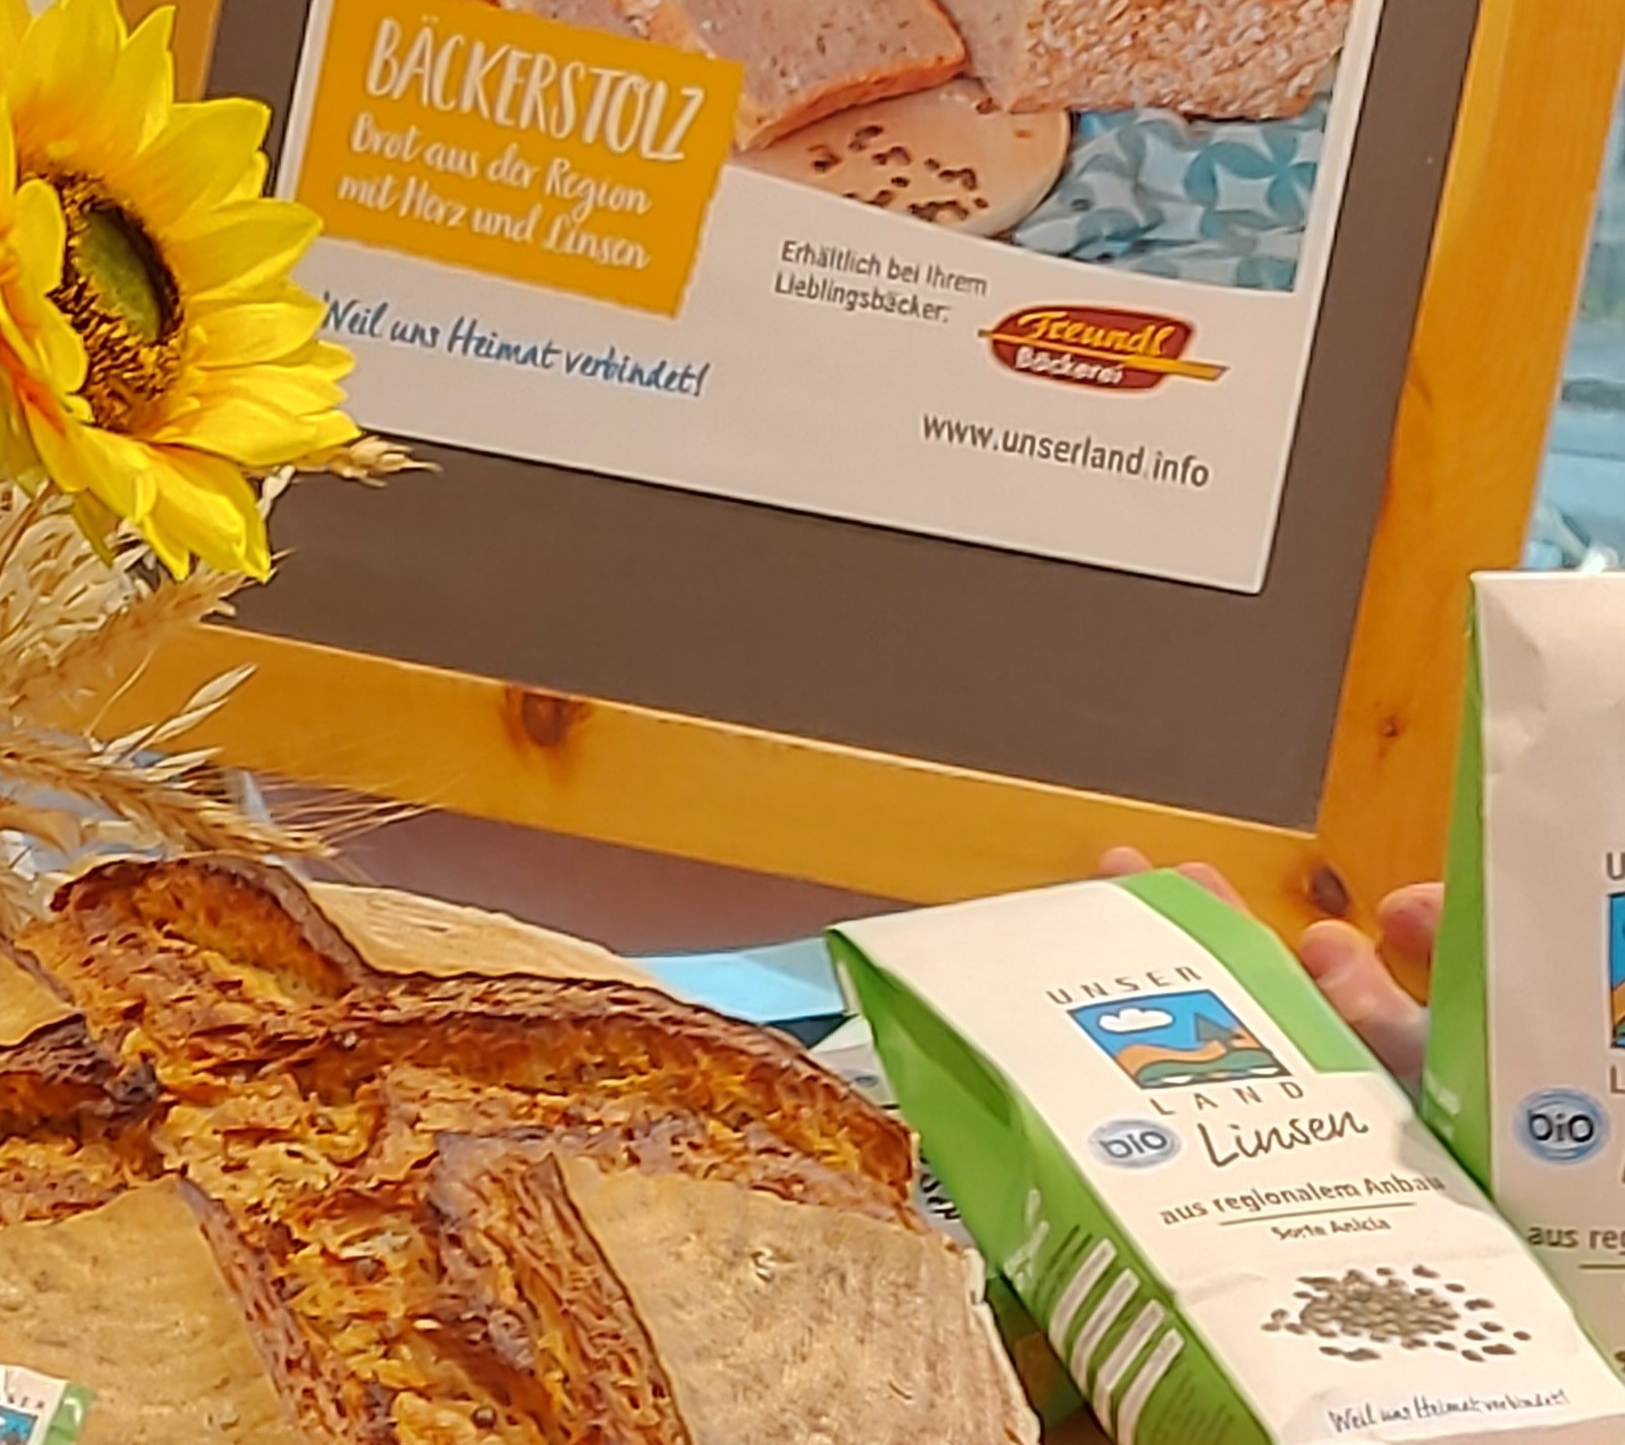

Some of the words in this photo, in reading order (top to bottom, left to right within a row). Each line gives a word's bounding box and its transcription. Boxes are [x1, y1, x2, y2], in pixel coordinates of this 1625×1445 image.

[365, 14, 706, 161] BÄCKERSTOLZ
[351, 111, 422, 156] Brot
[424, 140, 479, 180] aus
[486, 143, 537, 190] der
[545, 156, 651, 225] Region
[337, 171, 399, 207] mit
[400, 177, 467, 228] Herz
[474, 205, 543, 243] und
[542, 207, 651, 271] Linsen
[781, 238, 882, 278] Erhältlich
[886, 257, 921, 285] bei
[925, 258, 989, 297] Ihrem
[390, 319, 440, 349] uns
[446, 315, 561, 371] Heimat
[565, 345, 712, 398] verbindet!
[1017, 311, 1176, 356] Freundl
[1015, 346, 1126, 385] Bäckerei
[921, 412, 1211, 488] www.unserland.info
[1045, 965, 1204, 1006] UNSER
[1149, 1080, 1306, 1116] LAND
[1196, 1108, 1371, 1168] Linsen
[1159, 1198, 1209, 1226] aus
[1212, 1179, 1363, 1215] regionalem
[1364, 1172, 1445, 1199] Anbau
[1528, 1225, 1579, 1249] aus
